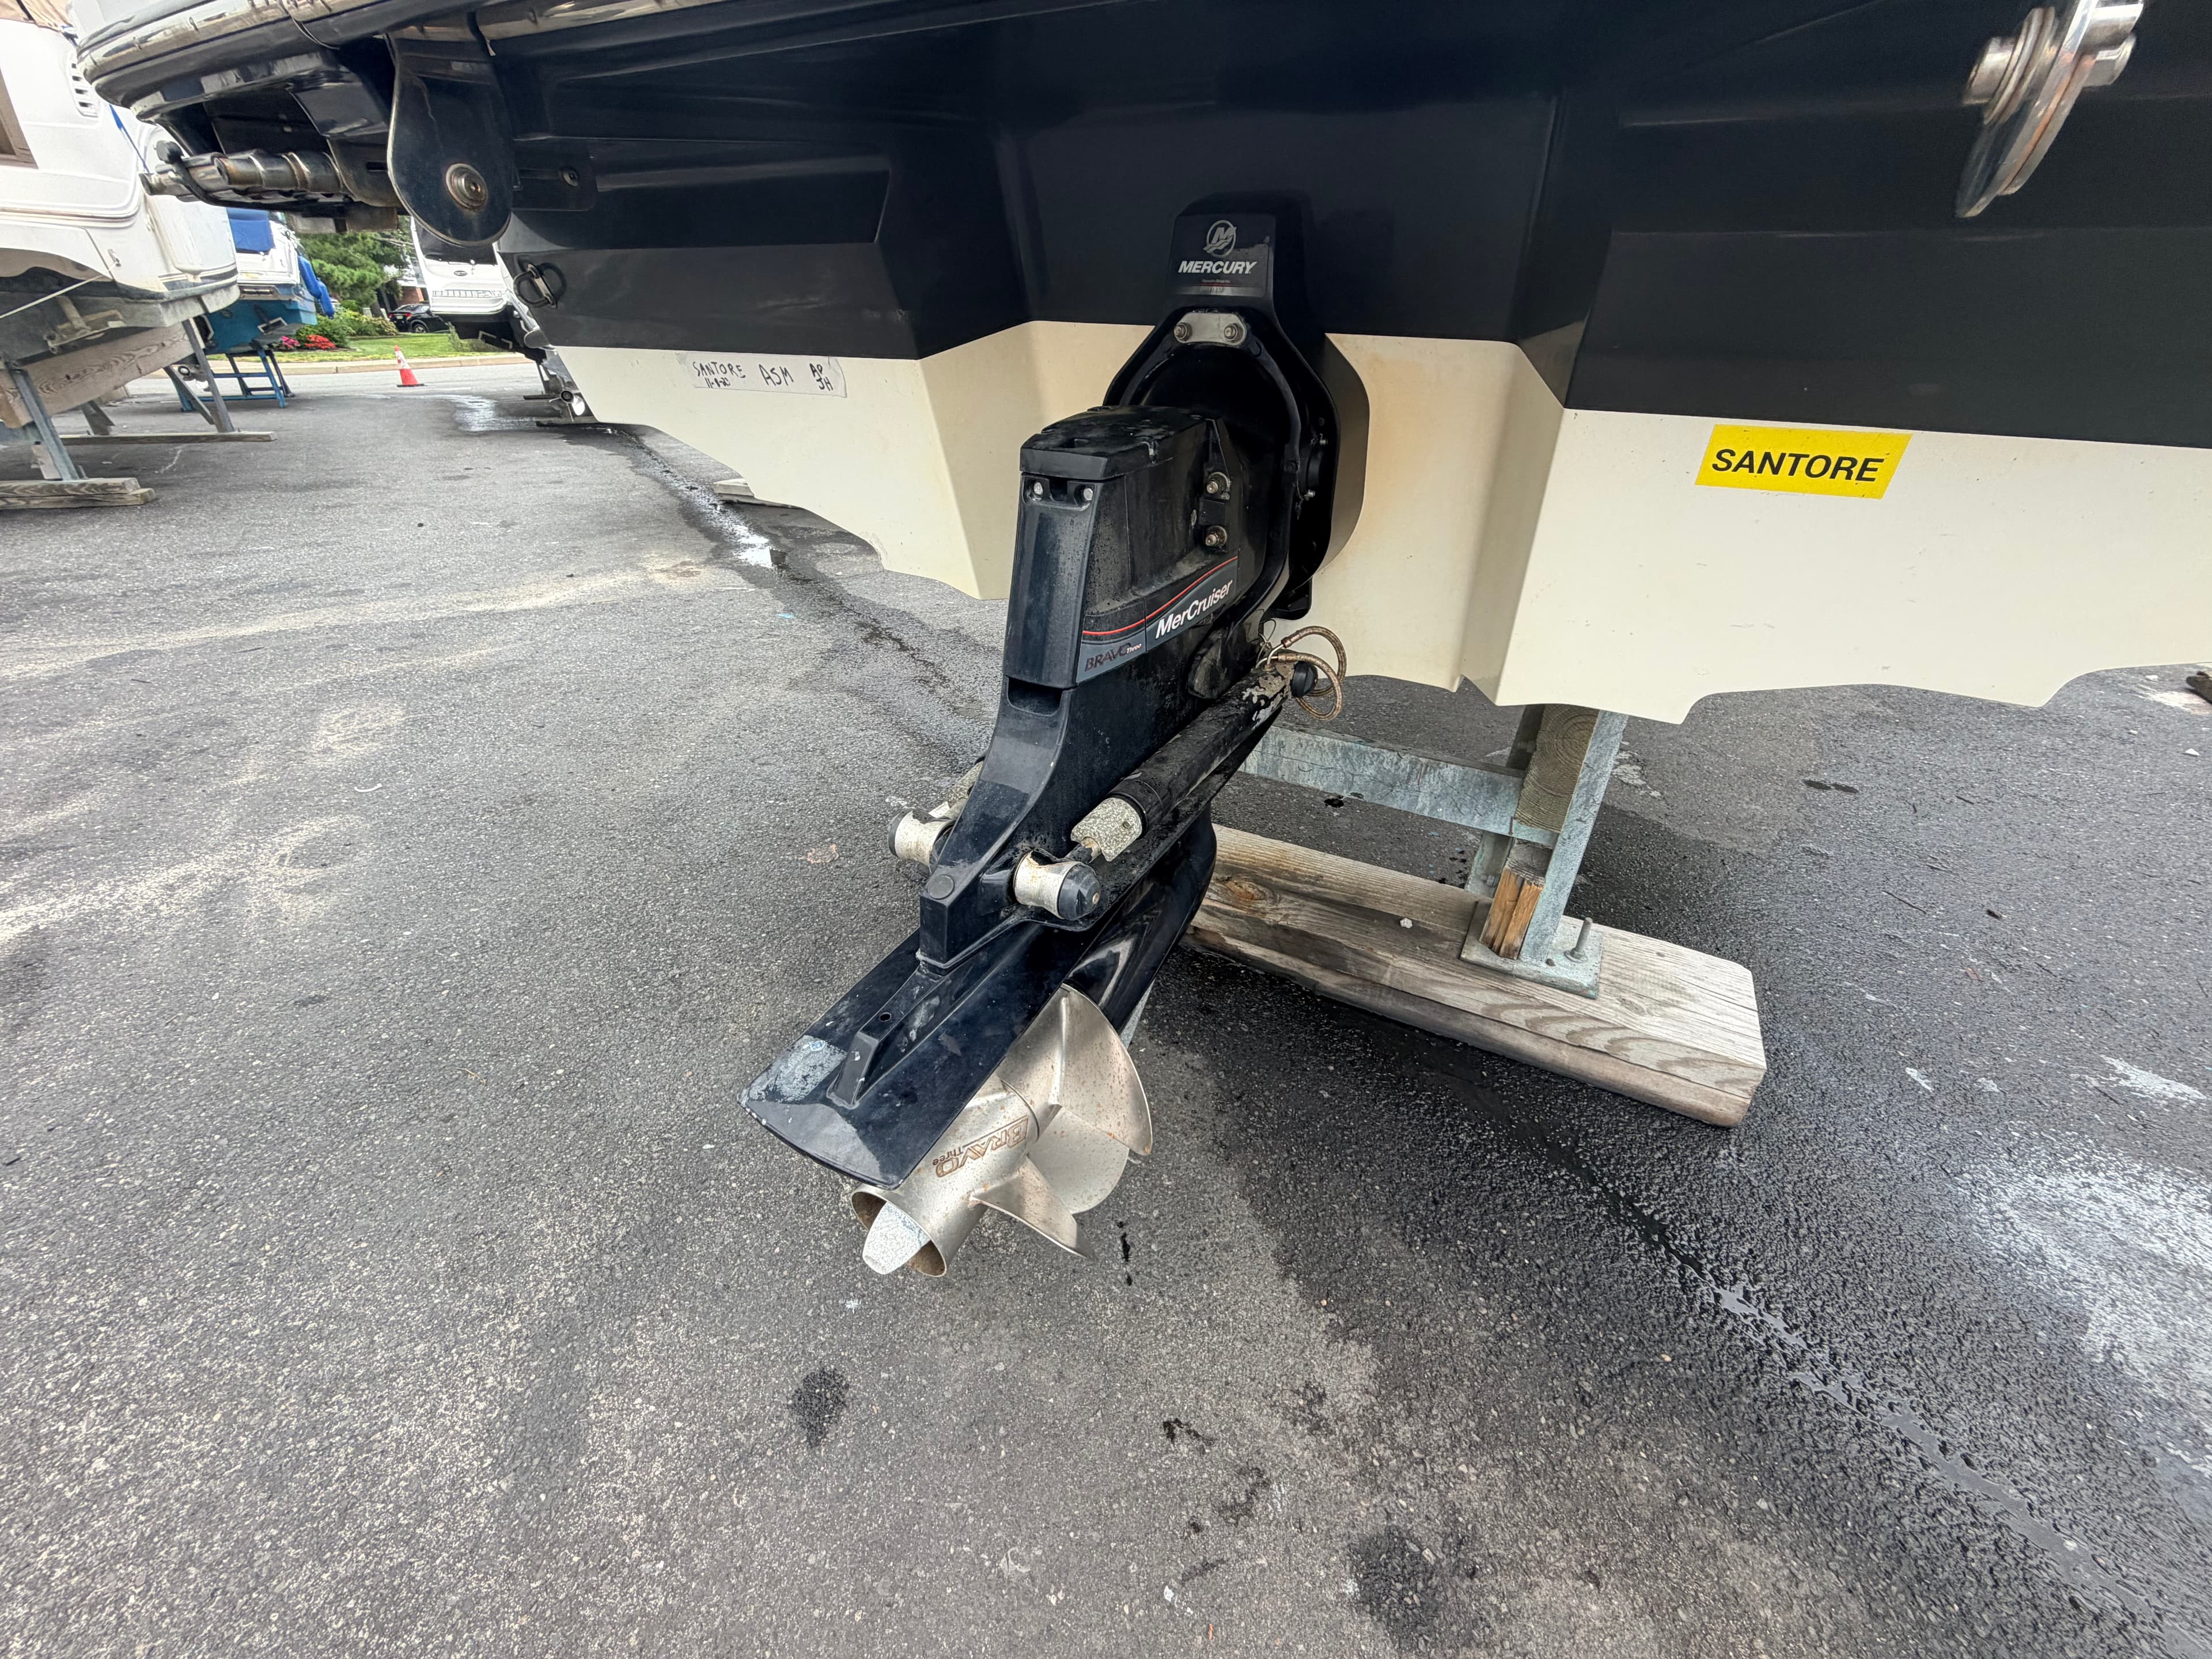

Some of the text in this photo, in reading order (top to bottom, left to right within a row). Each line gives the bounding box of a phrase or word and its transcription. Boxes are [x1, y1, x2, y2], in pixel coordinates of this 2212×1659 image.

[1178, 260, 1257, 274] MERCURY
[692, 361, 746, 378] SANTORE
[758, 363, 794, 387] ASM
[816, 376, 834, 391] JH
[1711, 448, 1885, 482] SANTORE
[1154, 579, 1233, 639] MerCruiser
[1084, 642, 1142, 672] BRAVO Three
[932, 1146, 964, 1166] Three
[935, 1118, 1029, 1178] BRAVO
